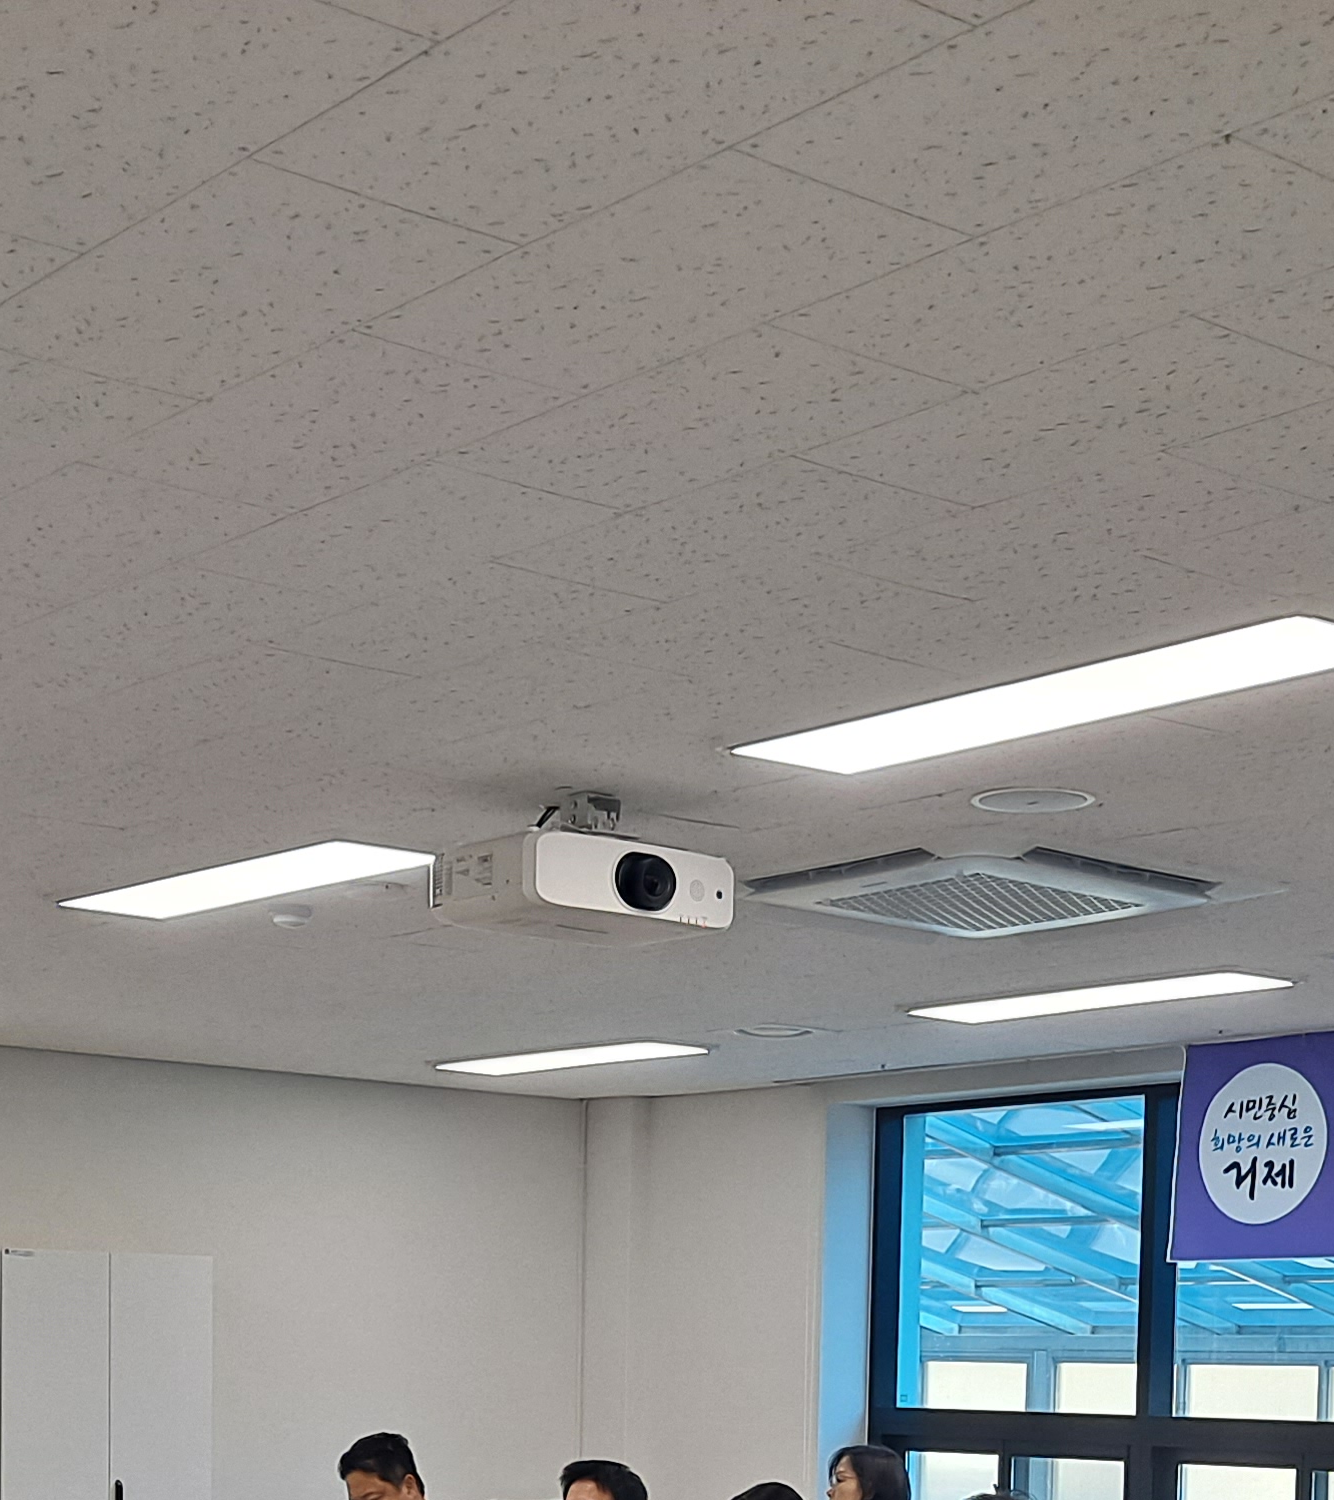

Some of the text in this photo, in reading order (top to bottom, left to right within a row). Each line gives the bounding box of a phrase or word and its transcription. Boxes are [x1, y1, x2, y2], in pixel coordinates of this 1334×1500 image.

[1223, 1093, 1298, 1122] 시민중심
[1210, 1125, 1315, 1154] 희망의 새로운
[1222, 1156, 1296, 1201] 거제
